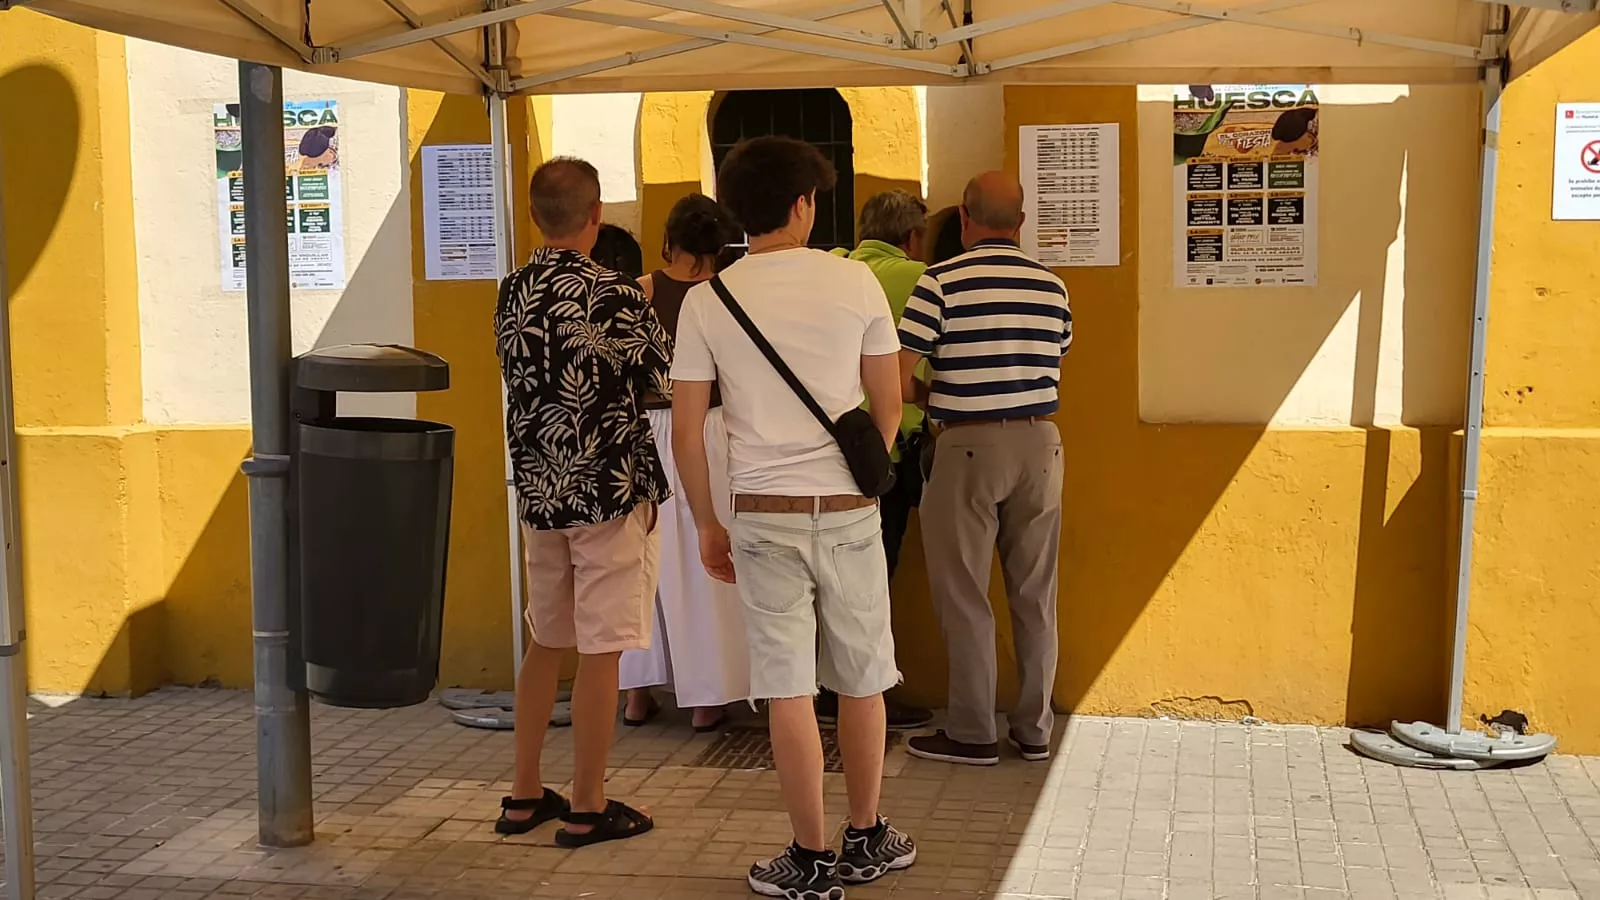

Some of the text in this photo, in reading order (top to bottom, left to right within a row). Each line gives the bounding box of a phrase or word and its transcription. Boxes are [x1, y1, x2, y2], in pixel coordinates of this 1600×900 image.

[1173, 90, 1319, 110] HUESCA
[213, 108, 338, 127] HSCA
[1237, 135, 1272, 149] FIESTA
